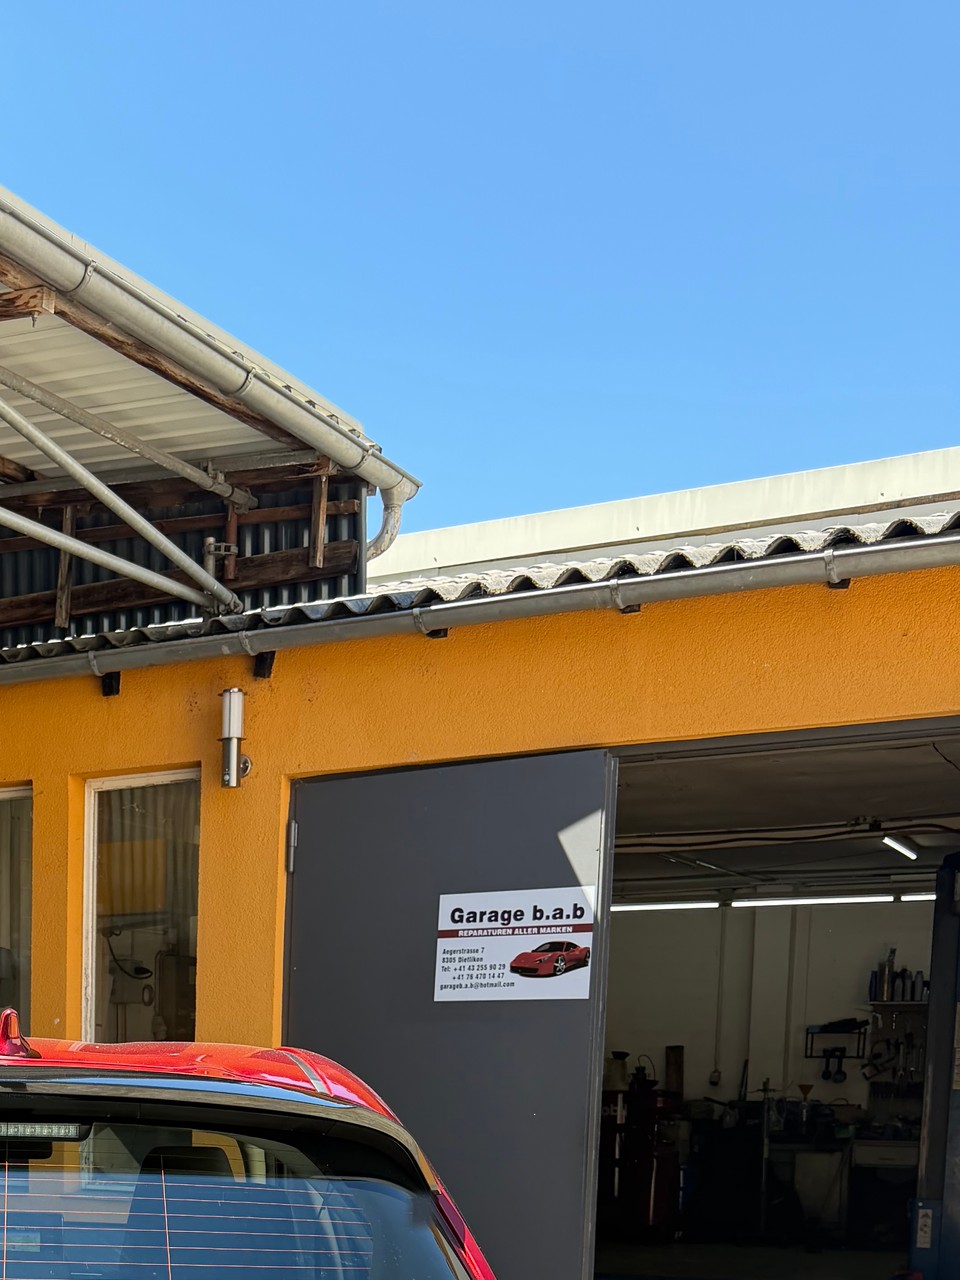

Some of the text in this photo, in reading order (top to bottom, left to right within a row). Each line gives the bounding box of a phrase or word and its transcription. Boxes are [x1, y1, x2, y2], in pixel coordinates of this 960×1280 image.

[450, 903, 585, 926] Garage b.a.b
[458, 926, 573, 937] REPARATUREN ALLER MARKEN
[442, 947, 479, 956] Aegerstrasse
[440, 981, 515, 990] garageb.a.b@hotmail.com
